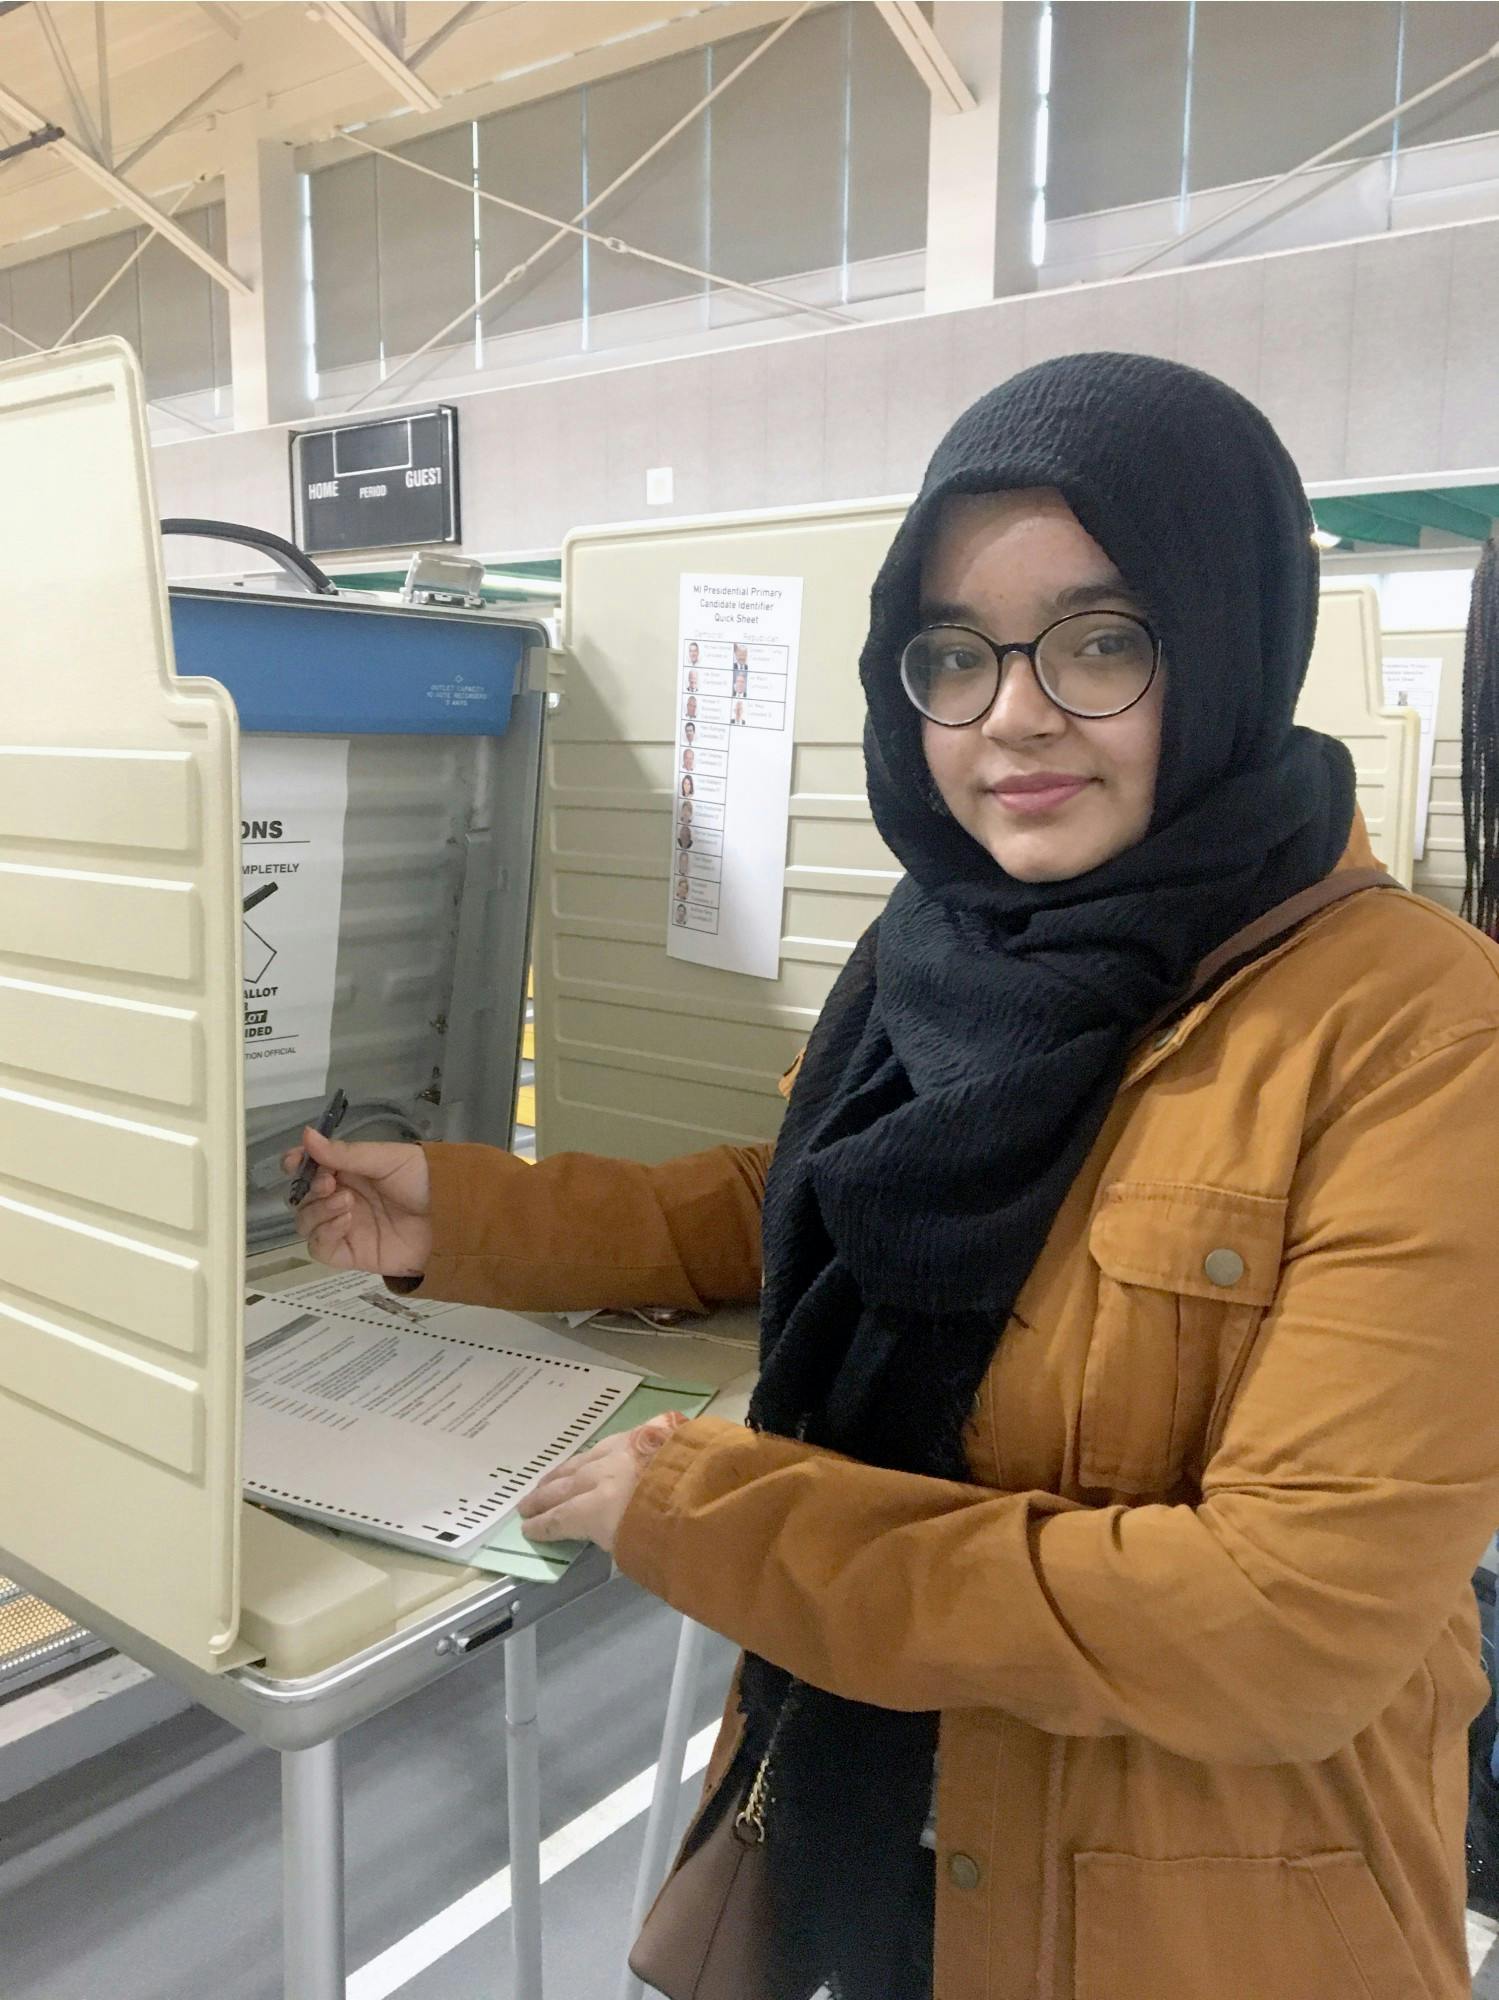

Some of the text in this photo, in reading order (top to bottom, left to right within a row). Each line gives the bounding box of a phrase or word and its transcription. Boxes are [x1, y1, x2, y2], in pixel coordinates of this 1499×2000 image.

[405, 467, 442, 489] GUEST
[308, 481, 340, 500] HOME
[359, 485, 388, 499] PERIOD
[703, 585, 749, 597] Presidential
[751, 587, 783, 599] Primary
[699, 598, 774, 612] Candidate Identifier
[714, 613, 760, 625] Quick Sheet
[264, 1047, 297, 1058] OFFICIAL
